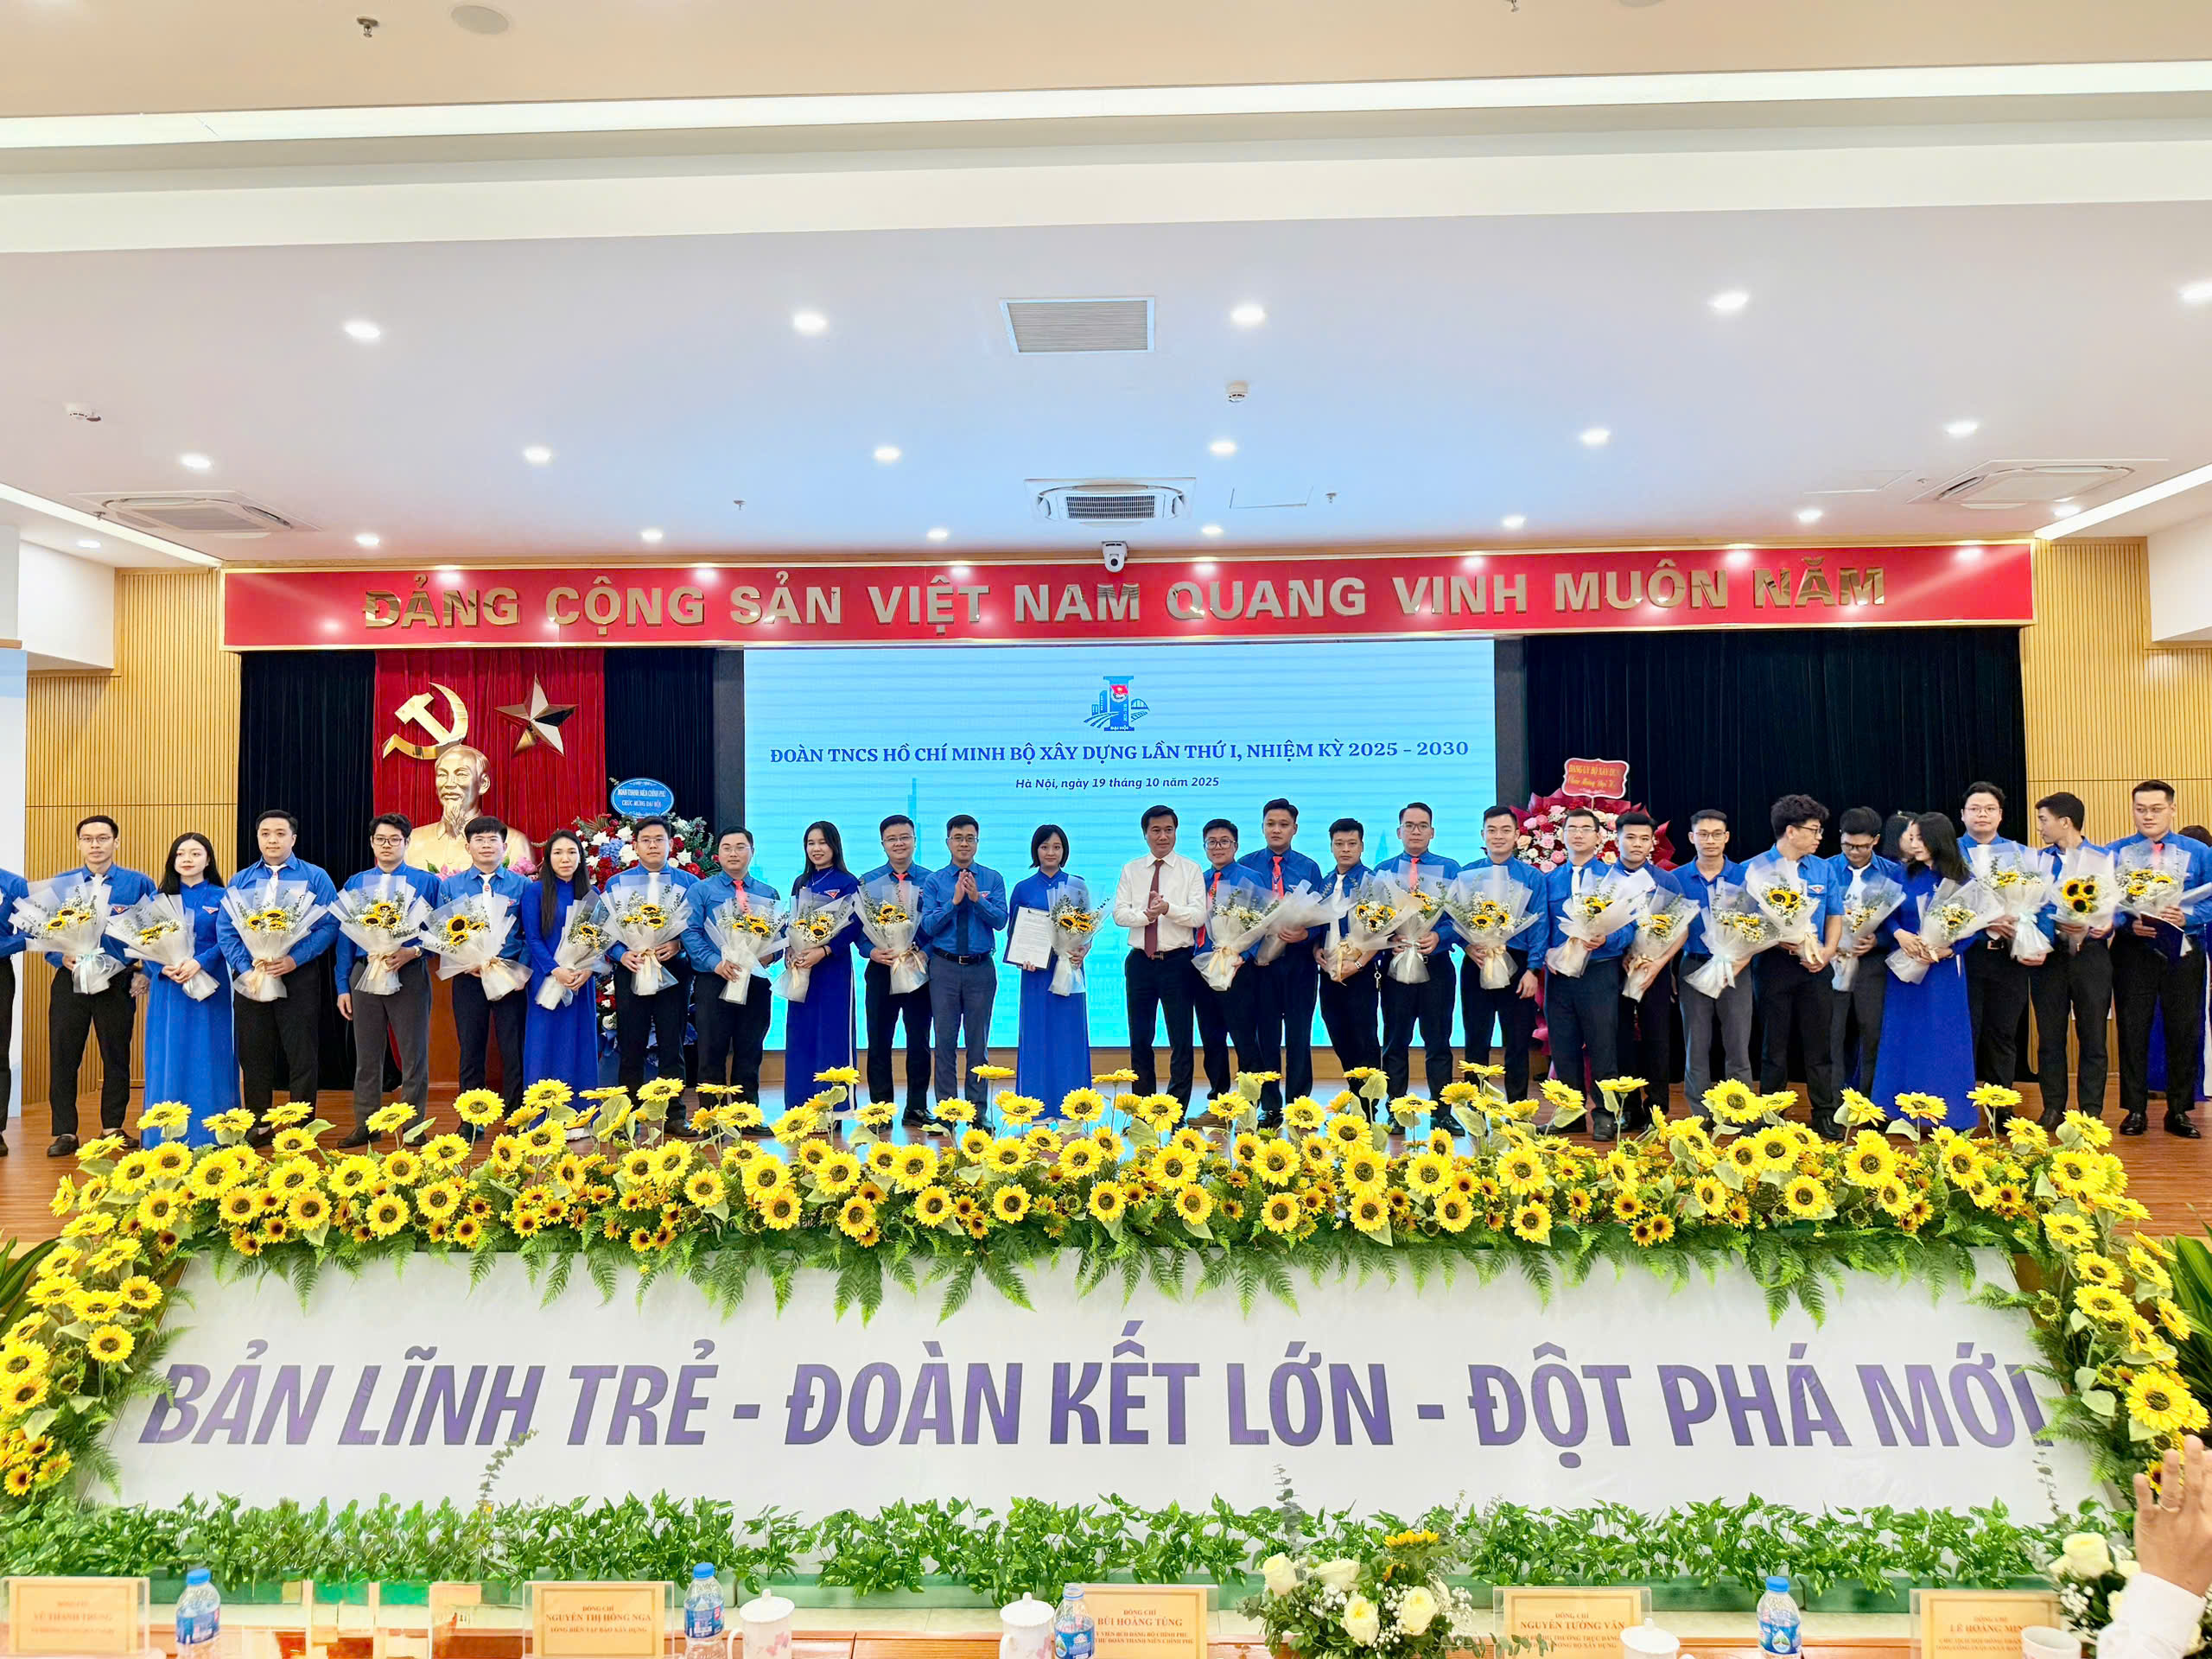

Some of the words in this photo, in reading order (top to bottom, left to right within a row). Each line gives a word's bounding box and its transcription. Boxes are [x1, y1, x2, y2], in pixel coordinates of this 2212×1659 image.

[362, 574, 519, 629] ĐẢNG
[545, 575, 704, 635] CỘNG
[729, 570, 841, 626] SẢN
[867, 575, 989, 635] VIỆT
[1014, 582, 1139, 623] NAM
[1166, 576, 1366, 620] QUANG
[1391, 574, 1527, 614] VINH
[1554, 559, 1726, 612] MUÔN
[1752, 556, 1885, 609] NĂM
[771, 744, 823, 763] ĐOÀN
[828, 748, 878, 762] TNCS
[883, 743, 910, 762] HỒ
[915, 743, 948, 761] CHÍ
[952, 747, 1005, 761] MINH
[1010, 742, 1035, 765] BỘ
[1039, 742, 1077, 760] XÂY
[1083, 744, 1137, 764] DỰNG
[1142, 741, 1180, 760] LẦN
[1185, 740, 1227, 759] THỨ
[1230, 744, 1241, 761] I,
[1247, 740, 1313, 762] NHIỆM
[1318, 739, 1344, 757] KỲ
[1349, 742, 1398, 757] 2025
[1417, 741, 1469, 756] 2030
[1015, 779, 1032, 788] Hà
[1035, 779, 1058, 791] Nội,
[1061, 779, 1089, 791] ngày
[1092, 779, 1106, 788] 19
[1109, 778, 1142, 790] tháng
[1146, 778, 1159, 787] 10
[1162, 778, 1188, 787] năm
[1192, 777, 1219, 787] 2025
[138, 1339, 334, 1445] BẢN
[337, 1346, 545, 1446] LĨNH
[567, 1339, 718, 1446] TRẺ
[785, 1341, 1023, 1446] ĐOÀN
[1049, 1319, 1199, 1445] KẾT
[1226, 1341, 1394, 1446] LỚN
[1468, 1341, 1631, 1469] ĐỘT
[1656, 1343, 1852, 1446] PHÁ
[1855, 1342, 2053, 1448] MỚI
[1097, 1616, 1114, 1626] BÙI
[1116, 1616, 1153, 1626] HOÀNG
[1155, 1616, 1183, 1626] TÙNG
[1604, 1619, 1624, 1630] VĂN
